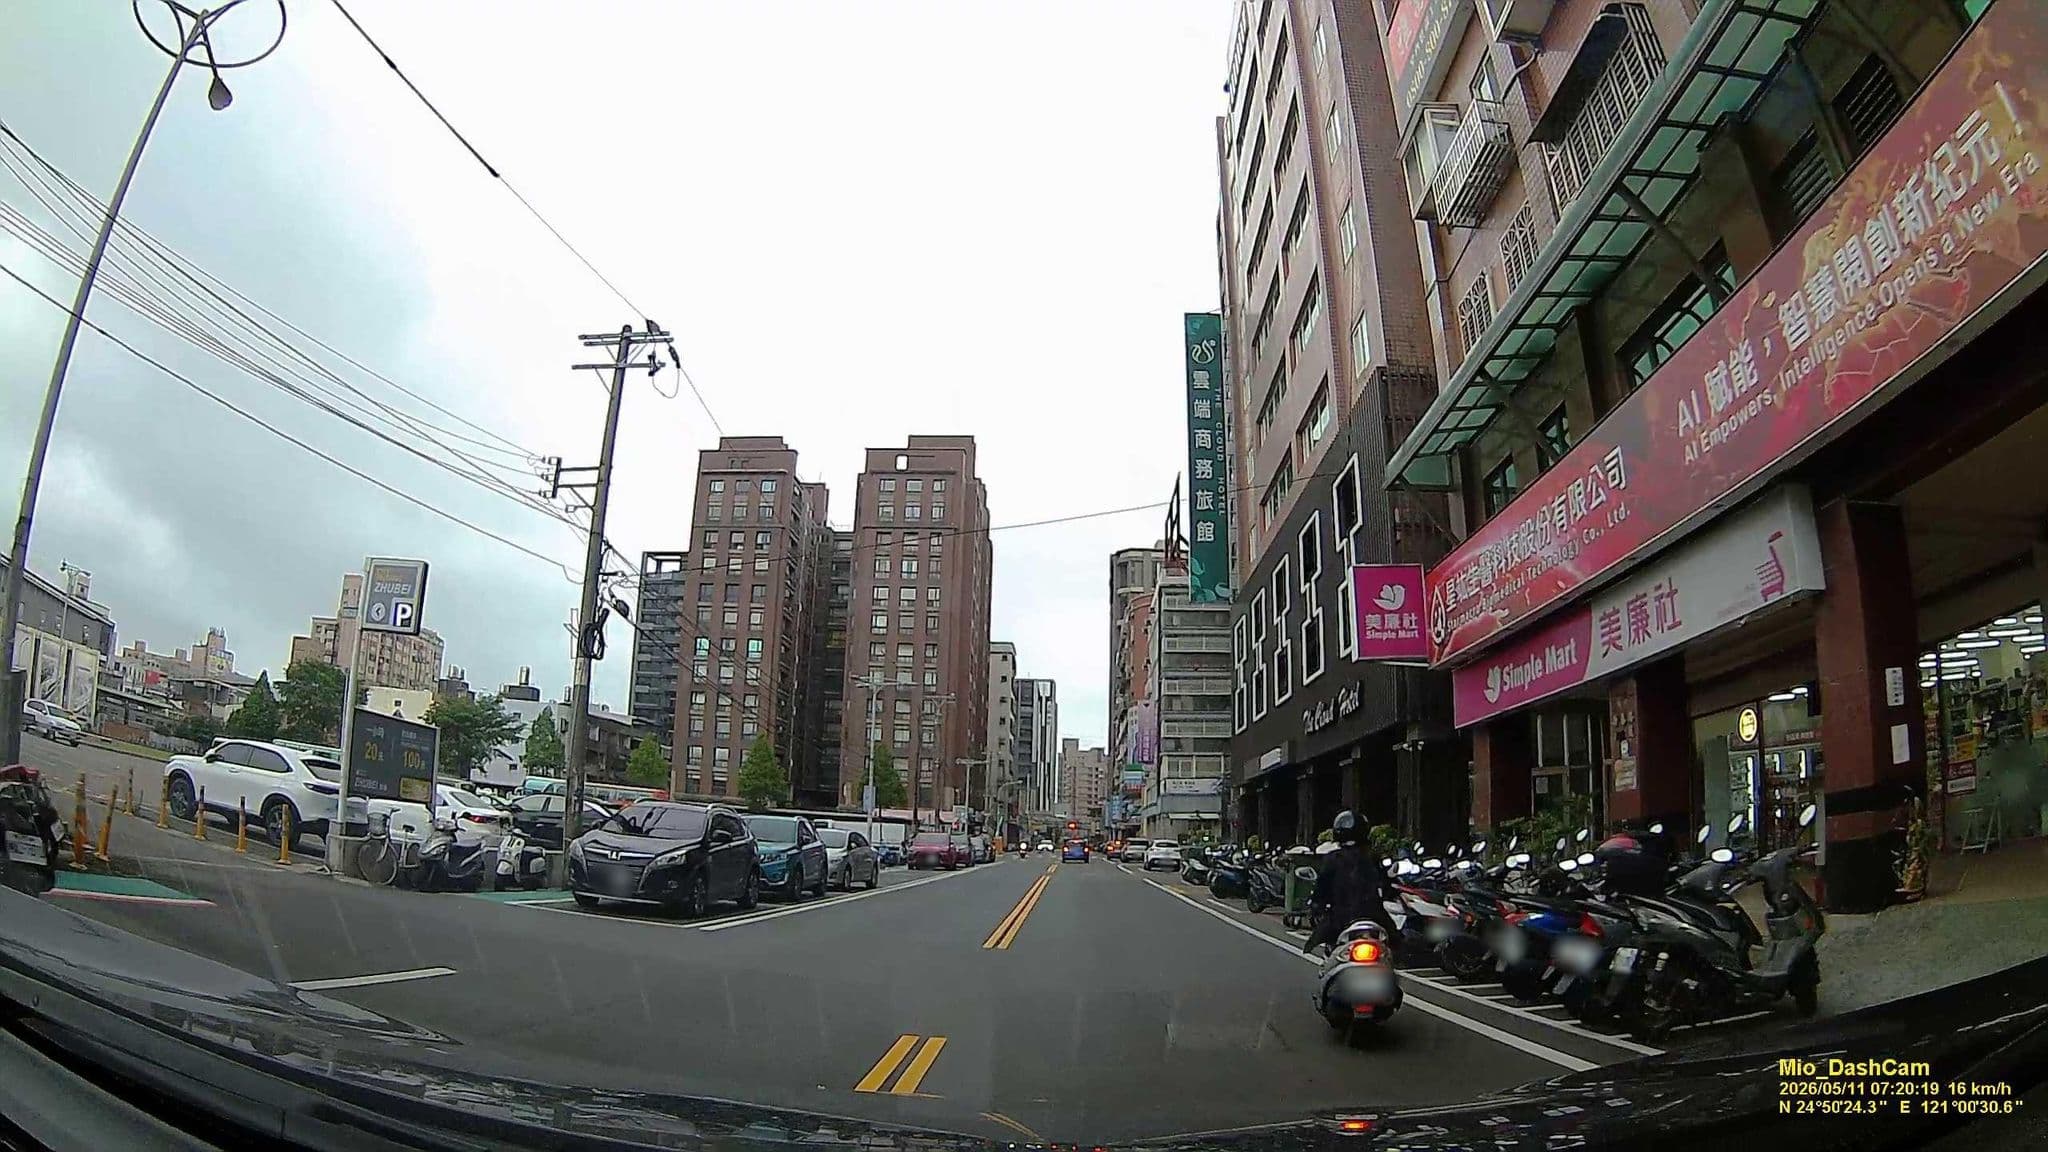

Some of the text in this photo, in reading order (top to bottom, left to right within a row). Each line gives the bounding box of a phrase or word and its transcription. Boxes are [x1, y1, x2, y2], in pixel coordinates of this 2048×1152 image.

[1684, 151, 2041, 465] AI Empowers, Intelligence Opens a New Era
[1678, 389, 1701, 437] AI
[1192, 370, 1214, 543] 雲端商務旅館
[1214, 388, 1226, 517] THE CLOUD HOTEL
[1527, 542, 1579, 579] Technology
[1582, 523, 1605, 545] Co.,
[1607, 502, 1631, 529] Ltd.
[375, 582, 411, 594] ZHUBEI
[396, 603, 412, 626] P
[1365, 613, 1419, 629] 美廉社
[1366, 629, 1418, 640] Simple Mart
[1600, 576, 1682, 658] 美廉社
[1503, 638, 1578, 691] Simple Mart
